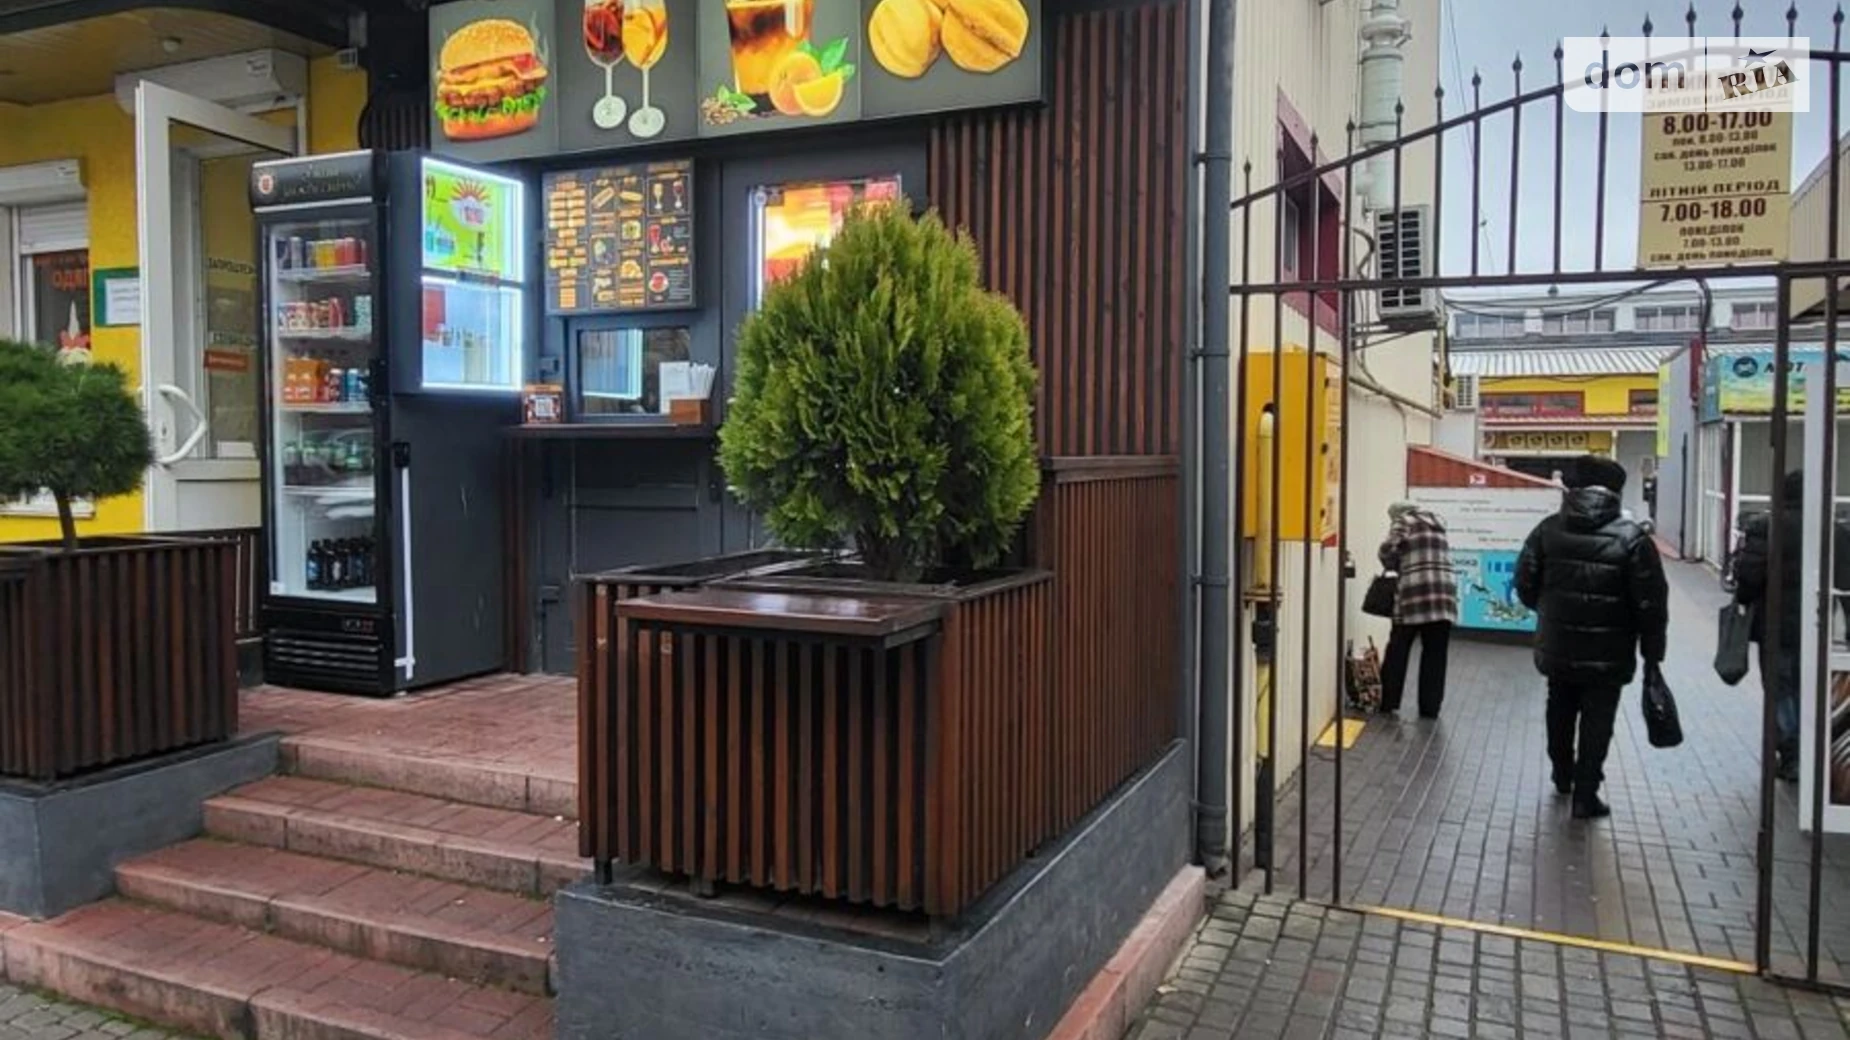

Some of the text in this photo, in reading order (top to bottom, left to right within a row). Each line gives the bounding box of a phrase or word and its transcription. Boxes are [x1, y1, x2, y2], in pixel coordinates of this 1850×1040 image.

[1663, 109, 1773, 135] 8.00-17.00
[1650, 180, 1780, 198] ЛІТНІЙ ПЕРІОД
[1660, 197, 1767, 222] 7.00-18.00
